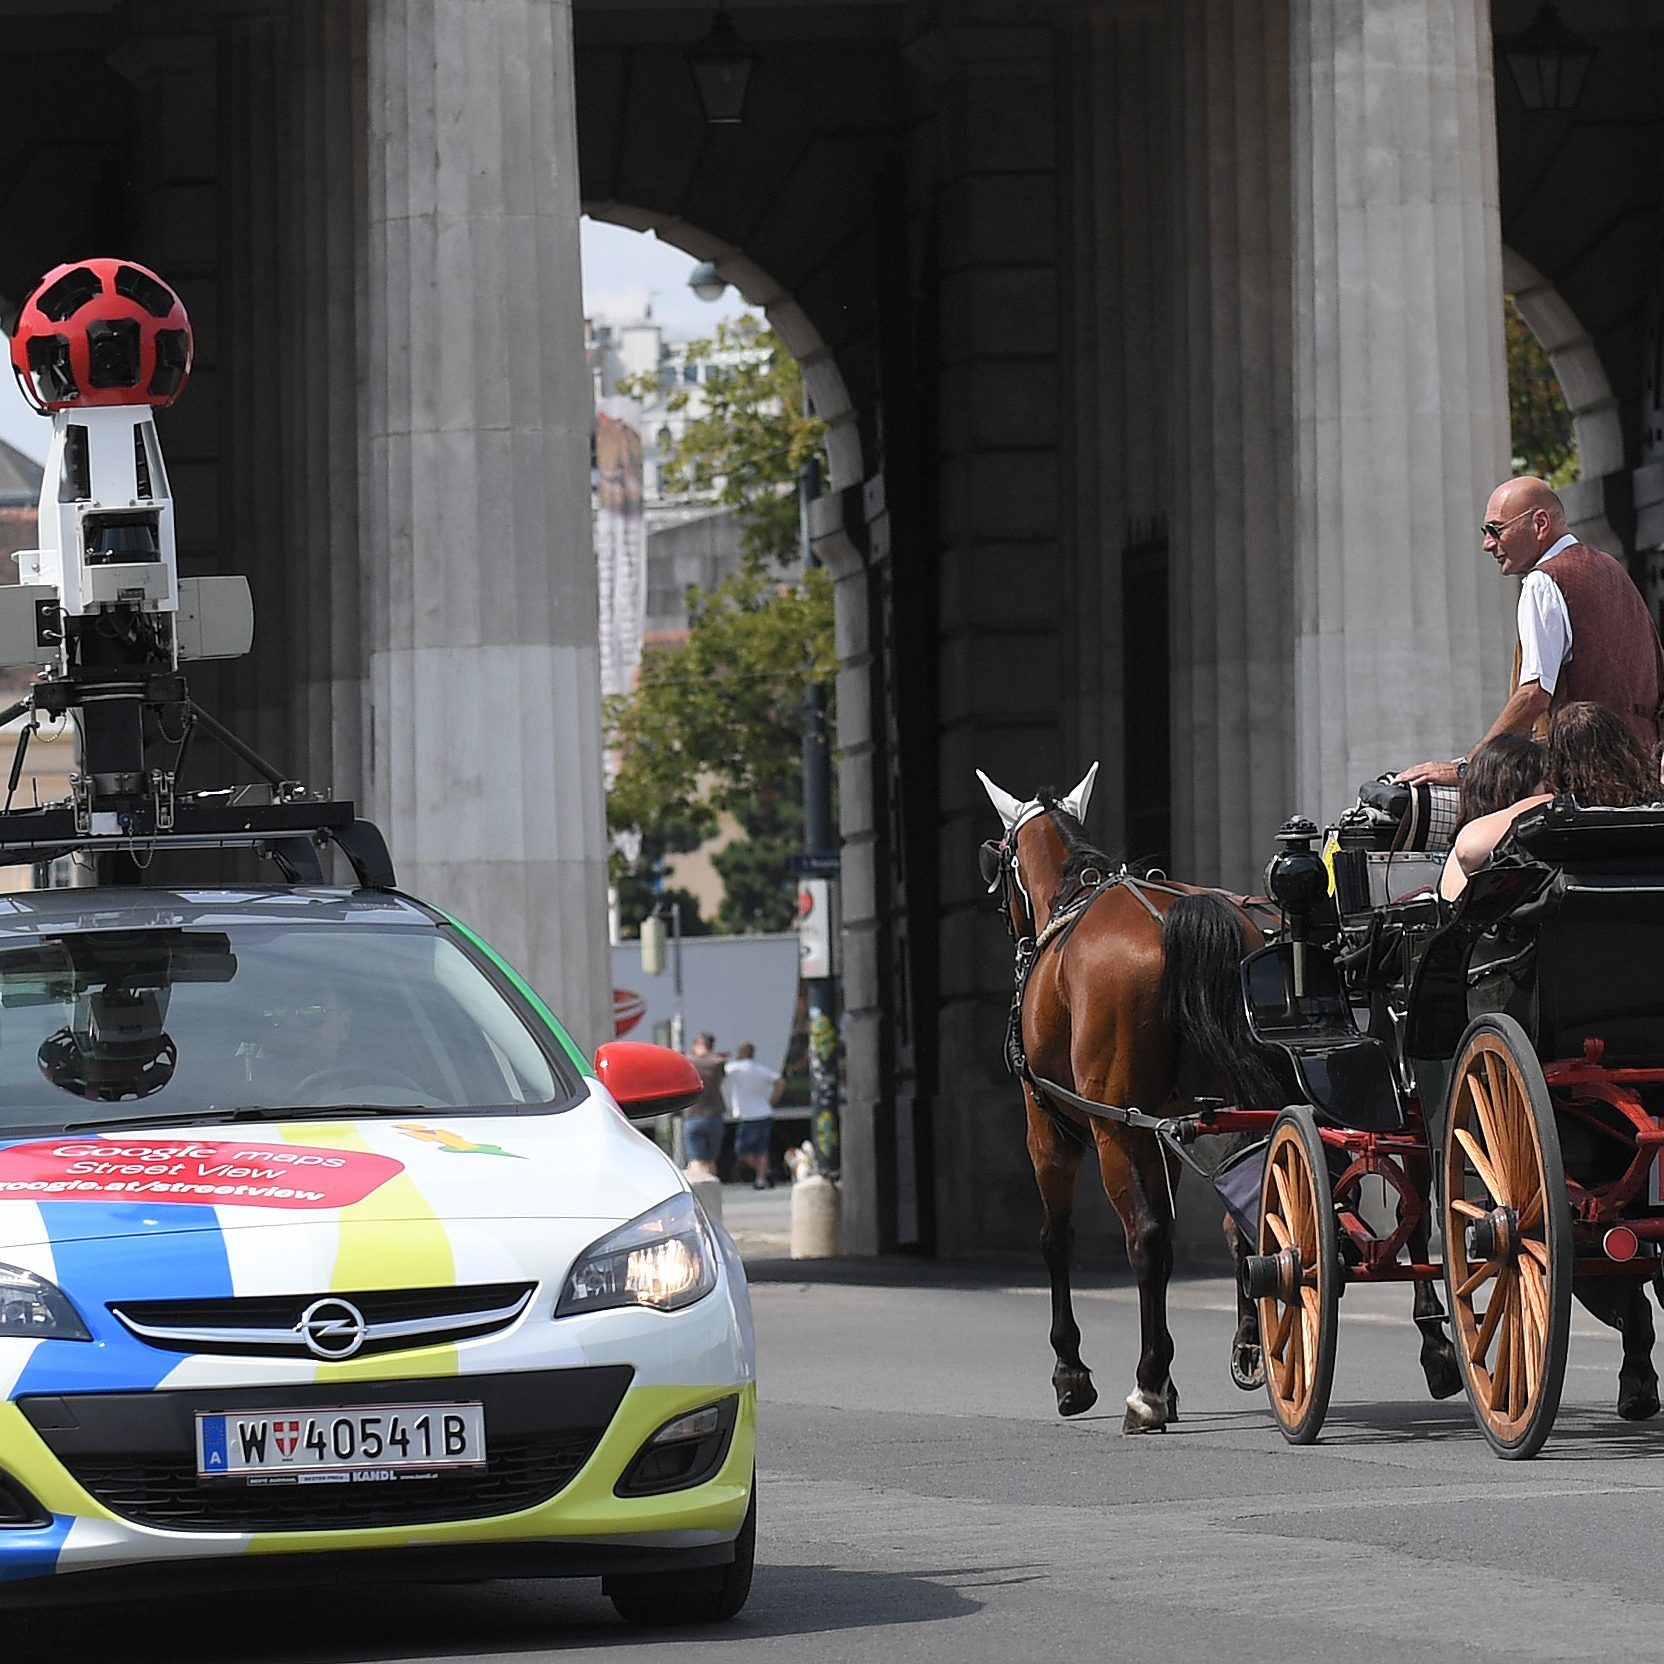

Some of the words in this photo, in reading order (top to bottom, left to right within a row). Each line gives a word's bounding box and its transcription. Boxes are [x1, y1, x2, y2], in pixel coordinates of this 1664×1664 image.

[53, 1144, 217, 1162] Google
[232, 1150, 346, 1168] maps
[66, 1161, 186, 1176] Street
[197, 1163, 287, 1180] View
[237, 1420, 268, 1464] W
[209, 1451, 222, 1465] A
[352, 1469, 397, 1482] KANDL
